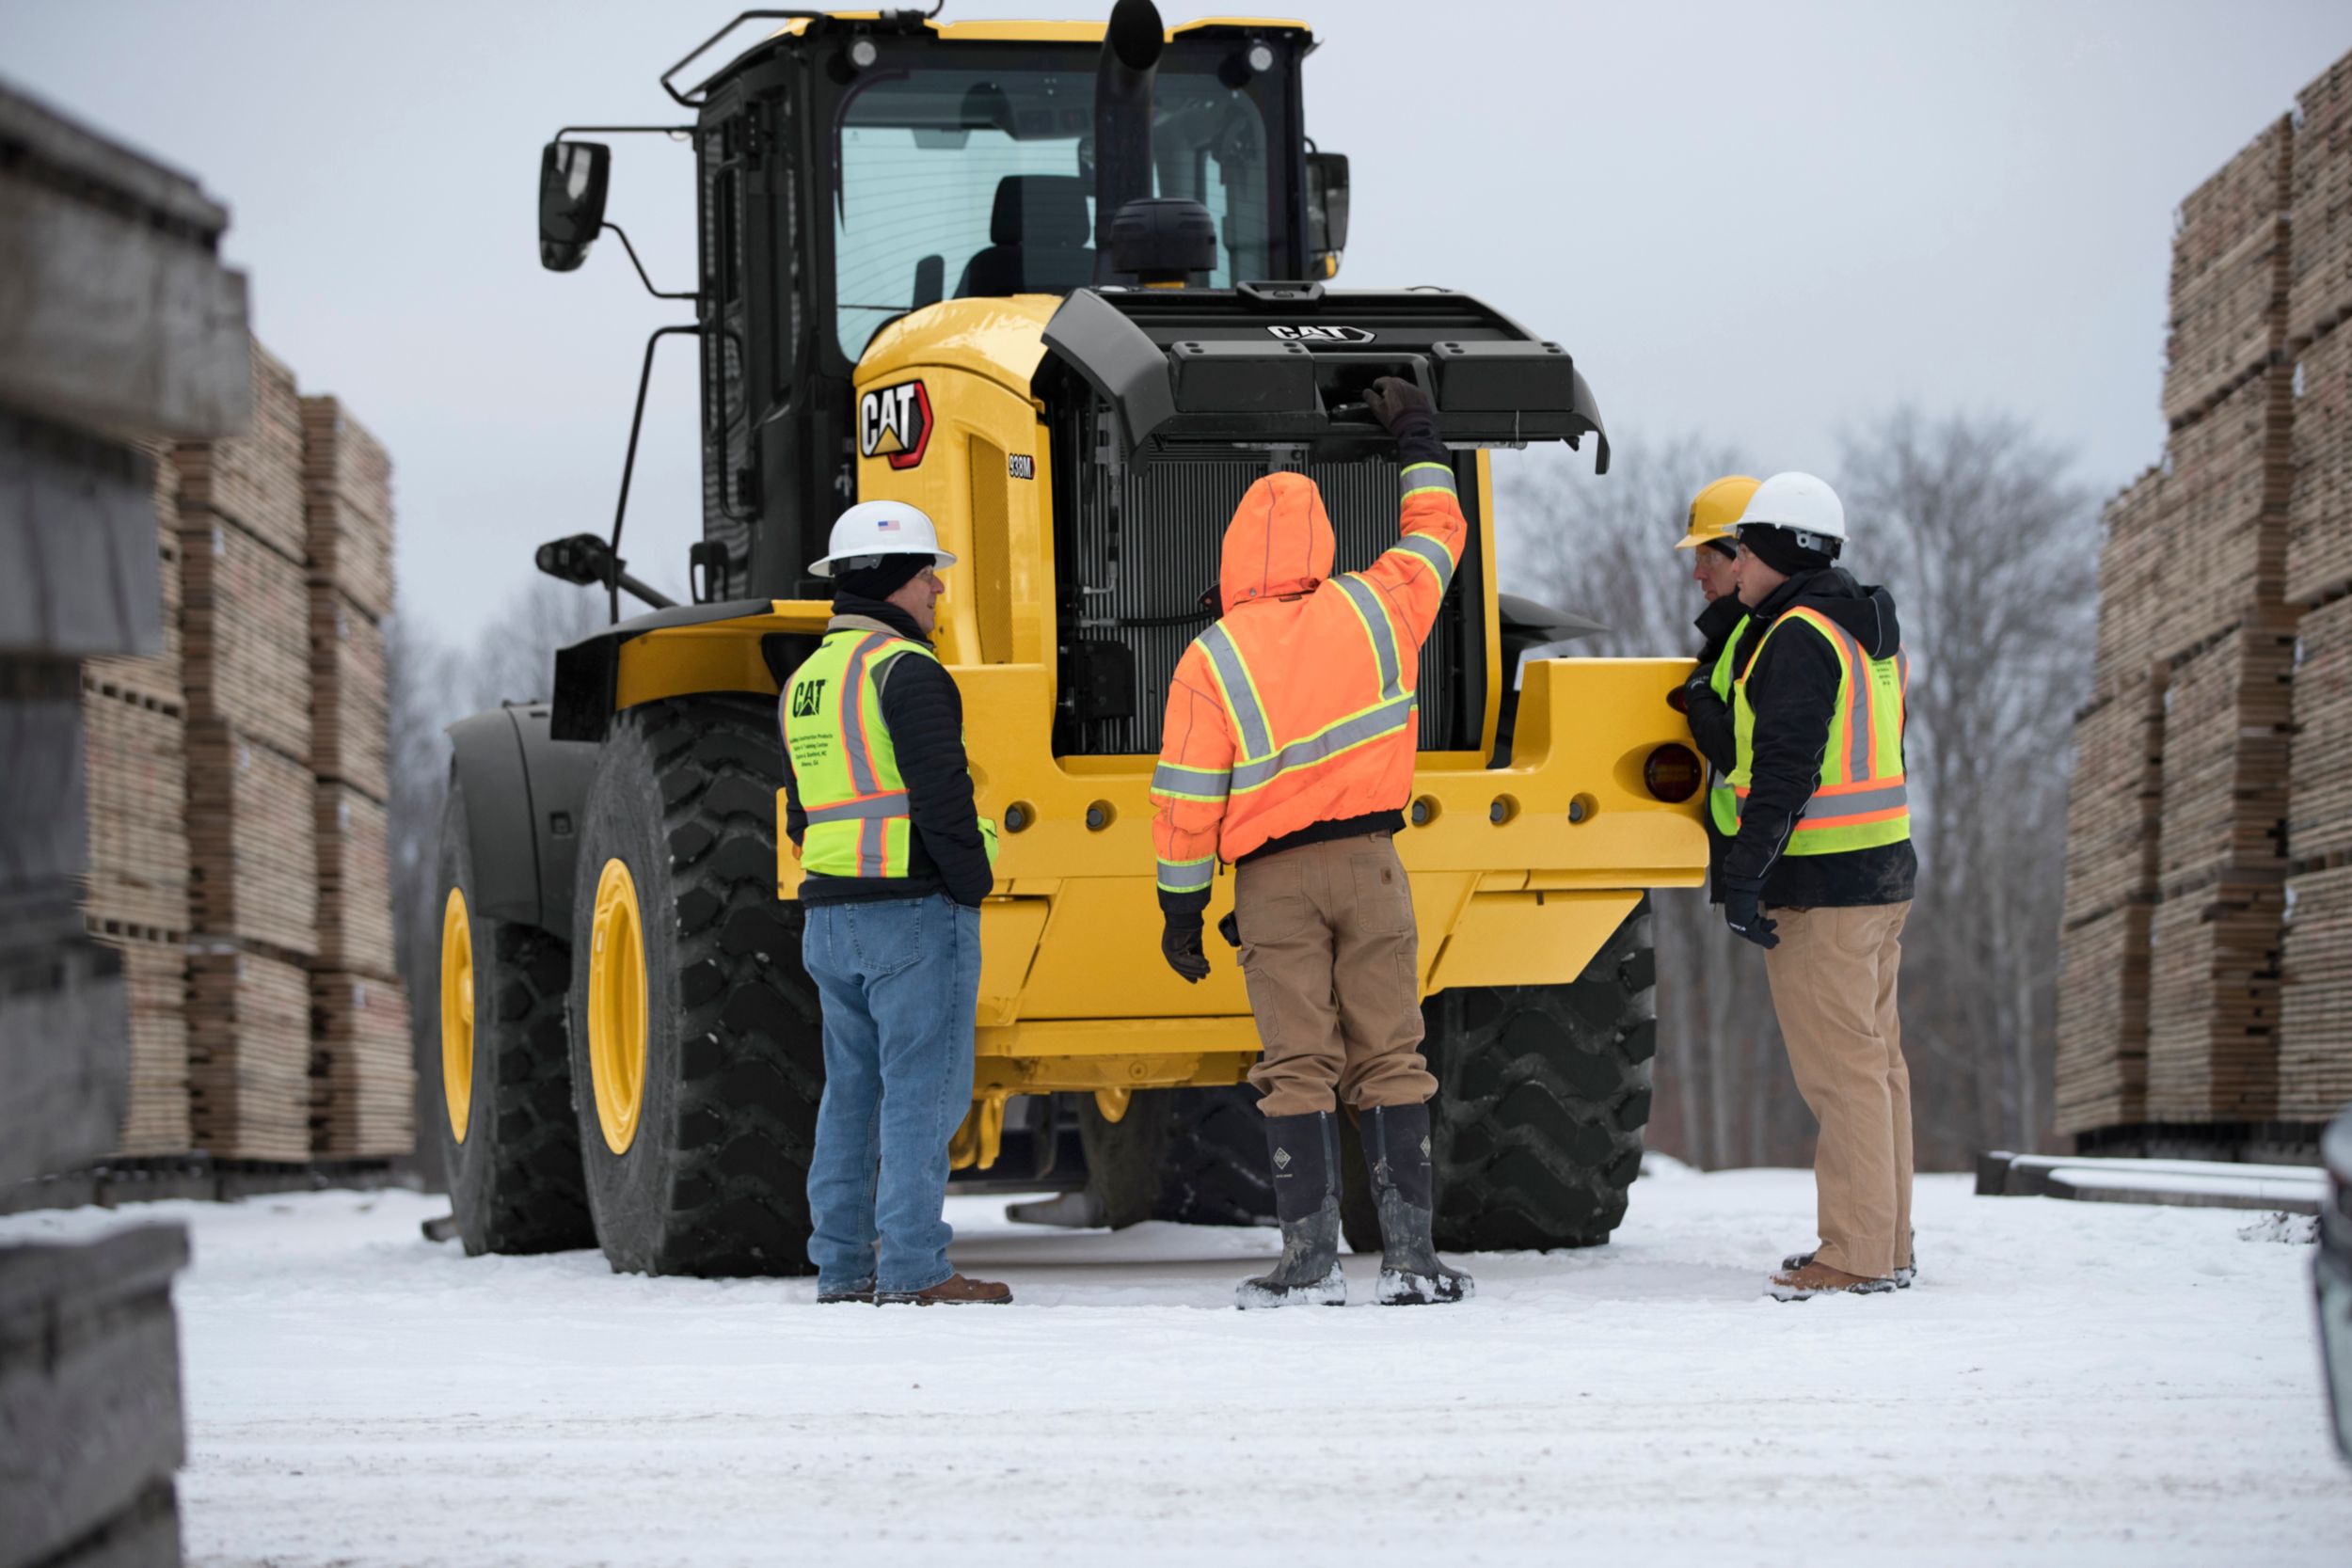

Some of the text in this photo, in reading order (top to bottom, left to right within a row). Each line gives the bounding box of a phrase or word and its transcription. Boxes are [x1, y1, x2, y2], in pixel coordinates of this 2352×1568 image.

[1266, 325, 1348, 341] CAT
[861, 382, 915, 457] CAT
[1009, 453, 1031, 479] 938M
[792, 679, 826, 719] CAT
